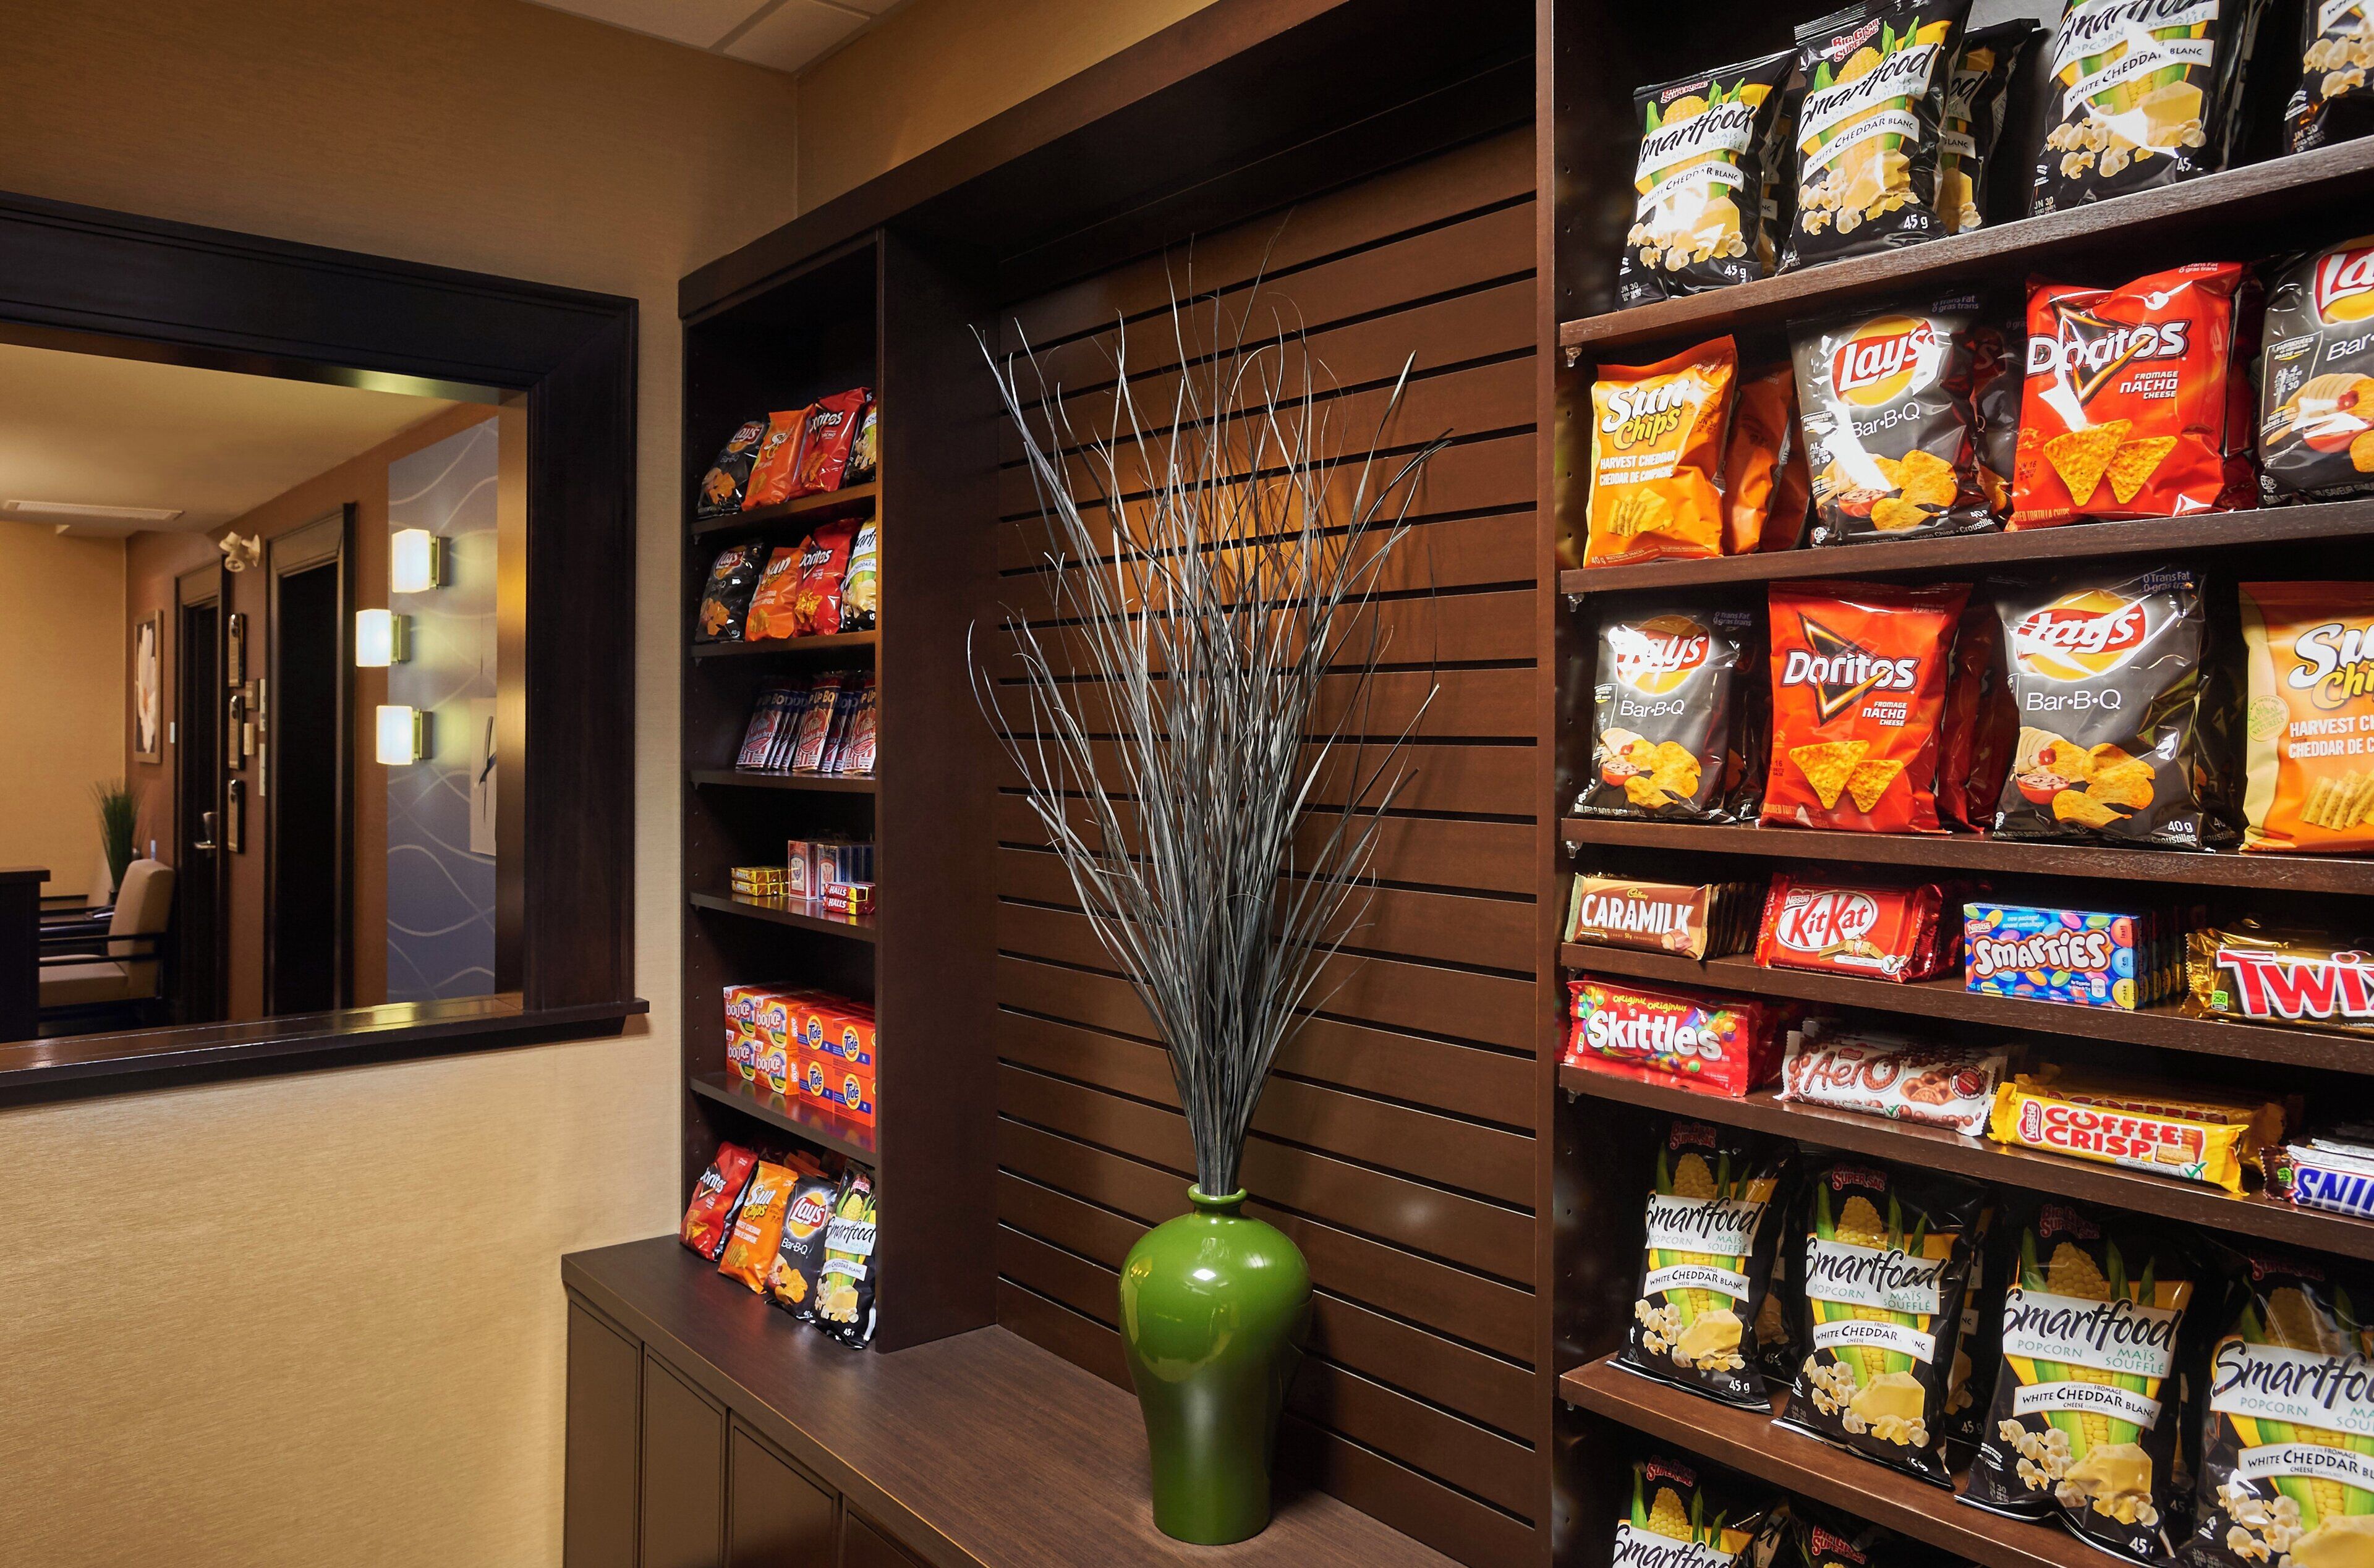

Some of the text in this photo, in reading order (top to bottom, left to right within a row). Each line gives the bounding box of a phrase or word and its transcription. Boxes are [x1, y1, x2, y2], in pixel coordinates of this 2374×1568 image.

[2066, 27, 2124, 59] POPCORN
[2069, 78, 2100, 103] WHITE
[2169, 48, 2203, 56] BLANC
[1797, 43, 1940, 137] Smartfood
[1835, 118, 1885, 148] CHEDDAR
[1888, 119, 1913, 130] BLANC
[2307, 124, 2319, 135] 30
[1637, 105, 1757, 173] Smartfood
[2177, 158, 2192, 172] 45
[1714, 169, 1738, 181] BLANC
[2044, 196, 2054, 206] 30
[1904, 214, 1928, 230] 45 g
[1724, 265, 1747, 278] 45 g
[1630, 282, 1638, 290] 30
[1939, 301, 1978, 313] gras trans
[1961, 295, 1976, 303] Fat
[2027, 322, 2189, 375] Doritos
[1839, 328, 1936, 392] Lay's
[2135, 371, 2179, 381] FROMAGE
[2287, 379, 2300, 391] 30
[2143, 391, 2176, 400] CHEESE
[1601, 379, 1691, 434] Sun
[1613, 407, 1683, 451] Chips
[1600, 450, 1677, 470] HARVEST CHEDDAR
[1821, 455, 1831, 464] 30
[1599, 472, 1640, 487] CHEDDAR DE
[1970, 510, 1982, 519] 40
[2027, 509, 2052, 521] TORTILLA
[1591, 556, 1606, 566] 40 g
[2143, 570, 2190, 582] 0 Trans Fat
[2030, 612, 2141, 654] Lay's
[1783, 651, 1918, 690] Doritos
[1873, 701, 1907, 709] FROMAGE
[1879, 719, 1905, 727] CHEESE
[2290, 717, 2354, 738] HARVEST
[2289, 738, 2365, 758] CHEDDAR DE
[2168, 820, 2193, 834] 40 g
[2151, 833, 2197, 845] Croustilles
[829, 885, 846, 897] HALLS
[828, 897, 847, 909] HALLS
[1786, 894, 1811, 905] Nestlé
[1581, 894, 1695, 936] CARAMILK
[1967, 923, 1991, 931] Nestlé
[2213, 995, 2226, 1004] 250
[726, 1001, 750, 1017] bounce
[757, 1009, 781, 1027] bounce
[809, 1023, 821, 1041] Tide
[1587, 1009, 1722, 1062] Skittles
[728, 1043, 750, 1061] bounce
[844, 1035, 858, 1053] Tide
[756, 1055, 781, 1073] bounce
[809, 1070, 822, 1088] Tide
[846, 1083, 859, 1100] Tide
[2027, 1103, 2037, 1139] Nestlé
[2045, 1106, 2182, 1145] COFFEE
[1670, 1131, 1716, 1150] SUPER SAC
[2045, 1125, 2151, 1159] CRISP
[2127, 1159, 2148, 1168] NATURAL
[1832, 1171, 1868, 1191] SUPER
[1868, 1176, 1886, 1192] SAC
[744, 1183, 776, 1208] Sun
[743, 1203, 766, 1221] Chips
[790, 1197, 825, 1225] Lay's
[1645, 1193, 1766, 1239] Smartfood
[826, 1216, 876, 1244] Smartfood
[1650, 1234, 1693, 1246] POPCORN
[1716, 1234, 1742, 1245] MAÏS
[1707, 1242, 1748, 1255] SOUFFLÉ
[1805, 1237, 1949, 1292] Smartfood
[1649, 1269, 1743, 1290] WHITE CHEDDAR BLANC
[1813, 1284, 1866, 1299] POPCORN
[1890, 1290, 1921, 1302] MAÏS
[1883, 1298, 1931, 1312] SOUFFLÉ
[2002, 1287, 2183, 1352] Smartfood
[843, 1328, 852, 1336] 45
[1816, 1325, 1897, 1341] WHITE CHEDDAR
[2017, 1339, 2083, 1358] POPCORN
[2118, 1348, 2156, 1362] MAÏS
[2104, 1356, 2165, 1375] SOUFFLÉ
[1729, 1379, 1750, 1394] 45 g
[2093, 1384, 2122, 1396] FROMAGE
[2022, 1388, 2155, 1419] WHITE CHEDDAR BLANC
[2240, 1397, 2308, 1417] POPCORN
[1961, 1421, 1975, 1433] 45
[2247, 1454, 2281, 1469] WHITE
[2283, 1449, 2359, 1473] CHEDDAR
[2324, 1447, 2357, 1460] FROMAGE
[2289, 1466, 2314, 1475] CHEESE
[2170, 1499, 2186, 1514] 45
[2129, 1536, 2147, 1554] 45
